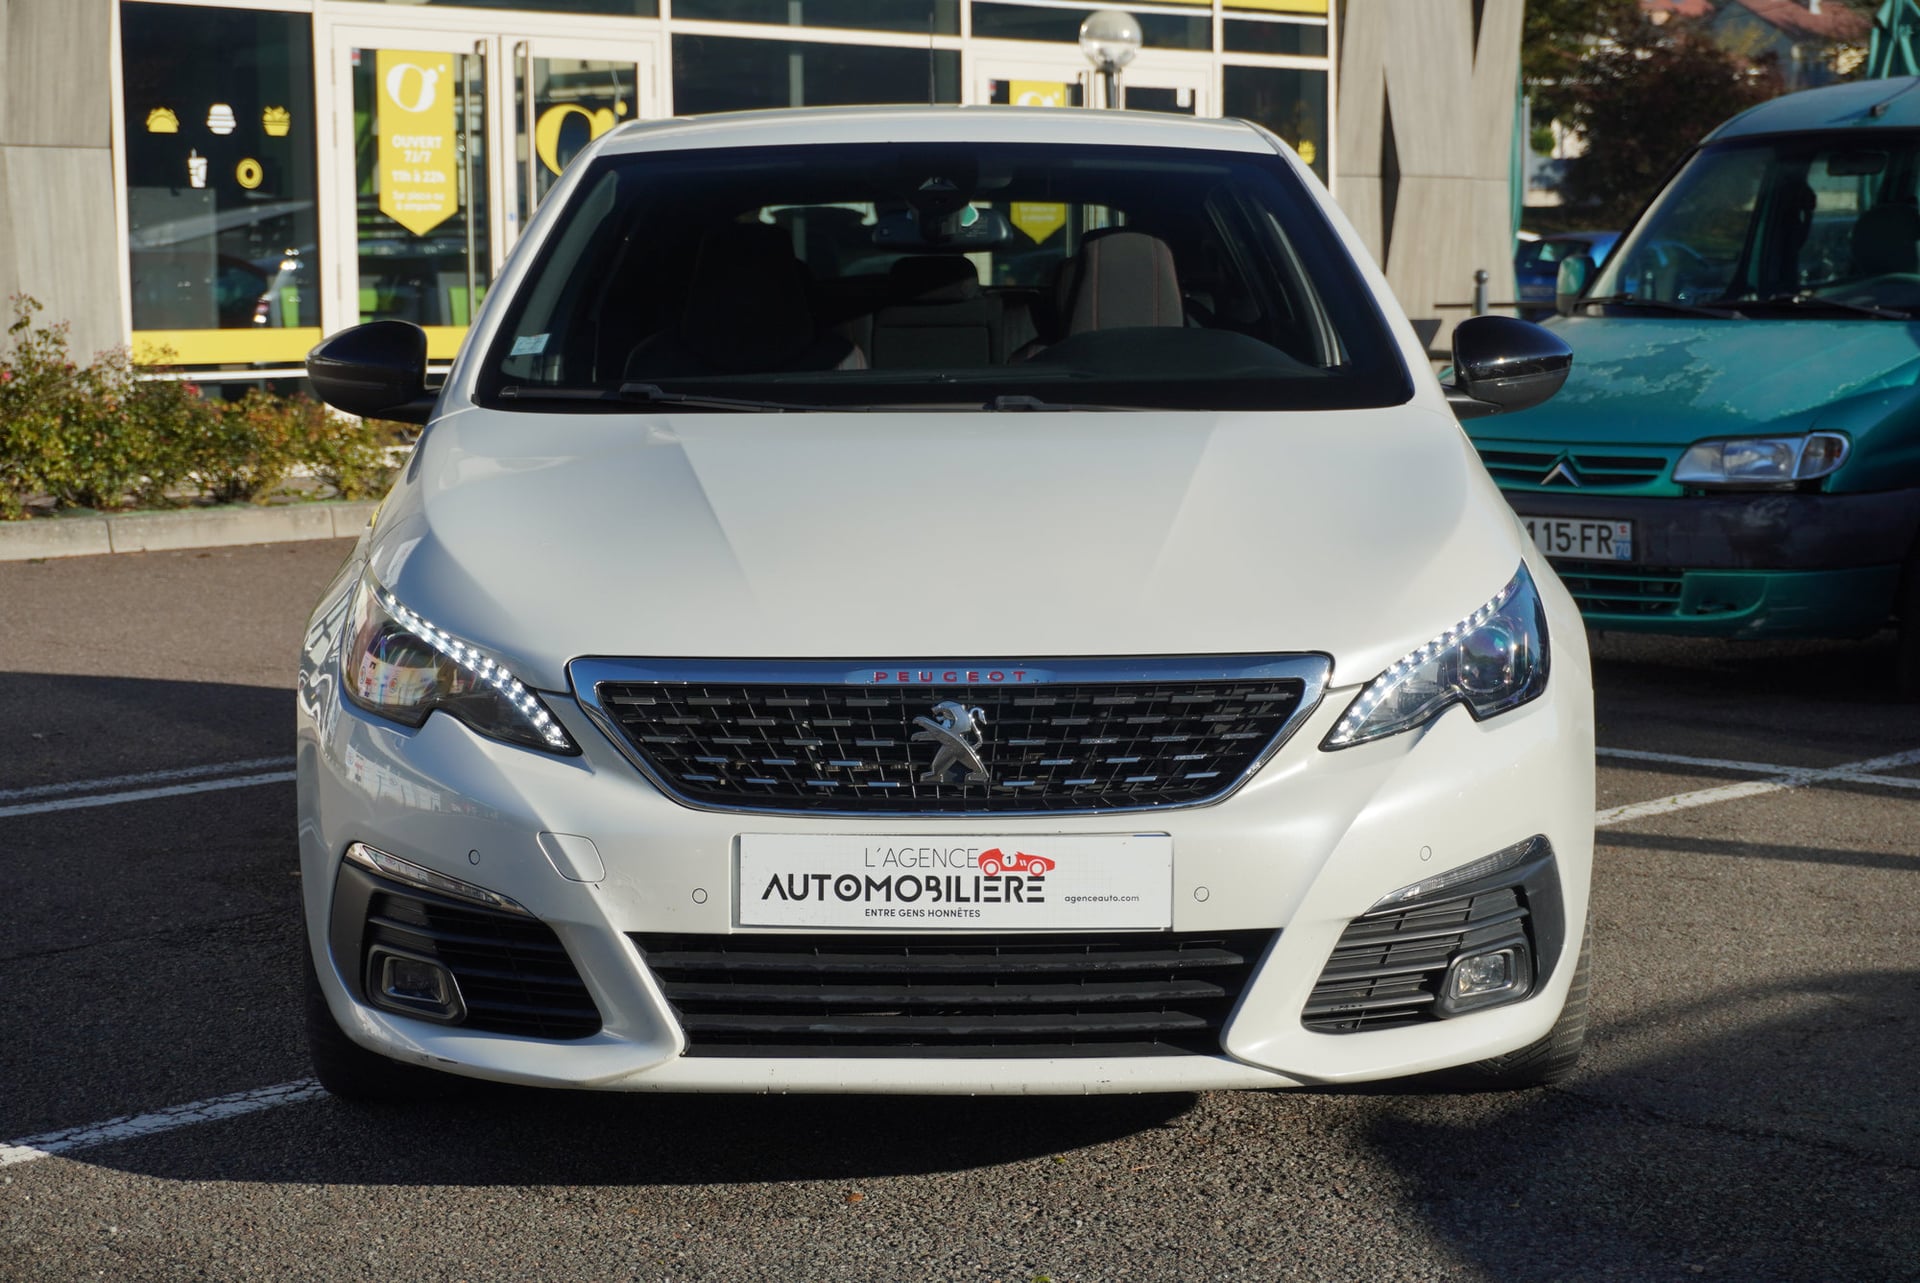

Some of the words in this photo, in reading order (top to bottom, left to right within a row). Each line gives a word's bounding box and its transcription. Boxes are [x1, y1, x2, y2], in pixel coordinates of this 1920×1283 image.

[392, 135, 442, 149] OUVERT
[1617, 542, 1631, 558] 70
[873, 671, 1026, 682] PEUGEOT
[865, 847, 979, 868] L'AGENCE
[1006, 855, 1012, 865] 1
[1064, 894, 1140, 904] agenceauto.com
[865, 908, 896, 917] ENTRE
[898, 908, 925, 917] GENS
[928, 906, 981, 918] HONNÊTES
